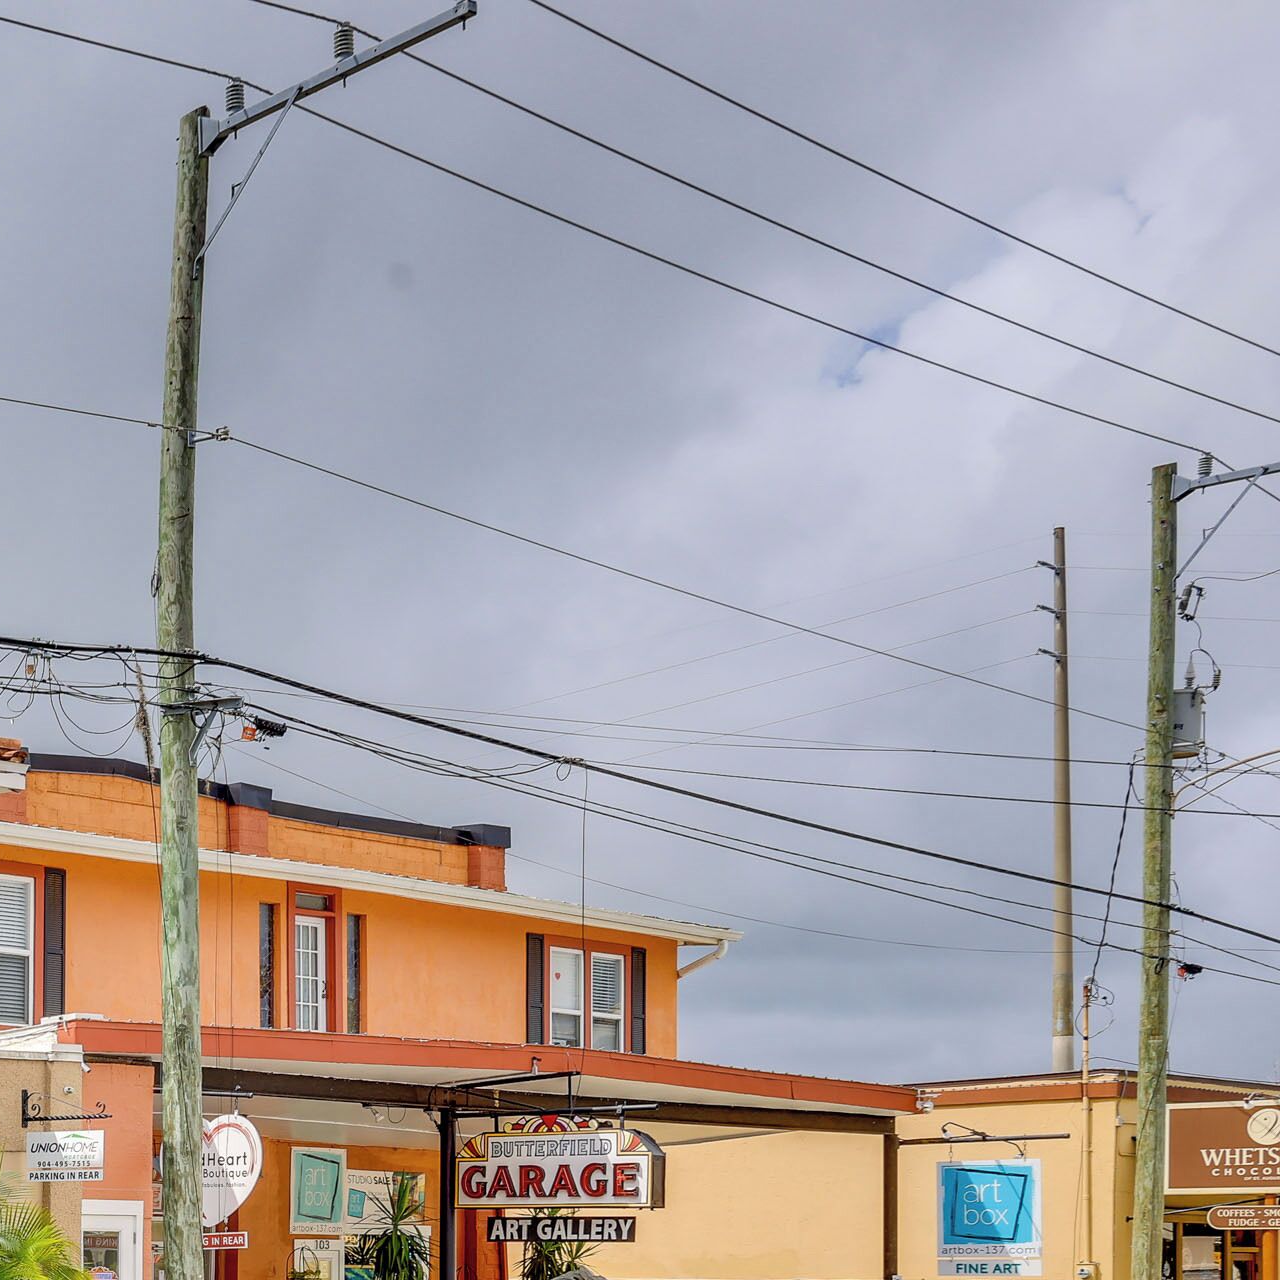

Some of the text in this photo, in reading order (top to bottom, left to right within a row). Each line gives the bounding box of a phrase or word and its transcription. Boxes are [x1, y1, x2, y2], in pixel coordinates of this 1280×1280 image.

[490, 1138, 613, 1158] BUTTERFIELD
[29, 1170, 100, 1180] PARKING IN REAR
[202, 1168, 248, 1180] Boutique
[304, 1167, 326, 1186] art
[347, 1174, 391, 1185] STUDIO SALE
[461, 1162, 642, 1200] GARAGE
[963, 1179, 1002, 1203] art
[304, 1186, 330, 1208] box
[963, 1204, 1009, 1225] box
[1217, 1208, 1255, 1217] COFFEES
[1228, 1218, 1259, 1227] FUDGE
[292, 1224, 342, 1233] artbox-137.com
[490, 1218, 634, 1241] ART GALLERY
[212, 1237, 220, 1245] IN
[223, 1236, 244, 1245] REAR
[315, 1240, 330, 1249] 103
[942, 1245, 1036, 1254] artbox-137.com
[956, 1263, 1022, 1274] FINE ART
